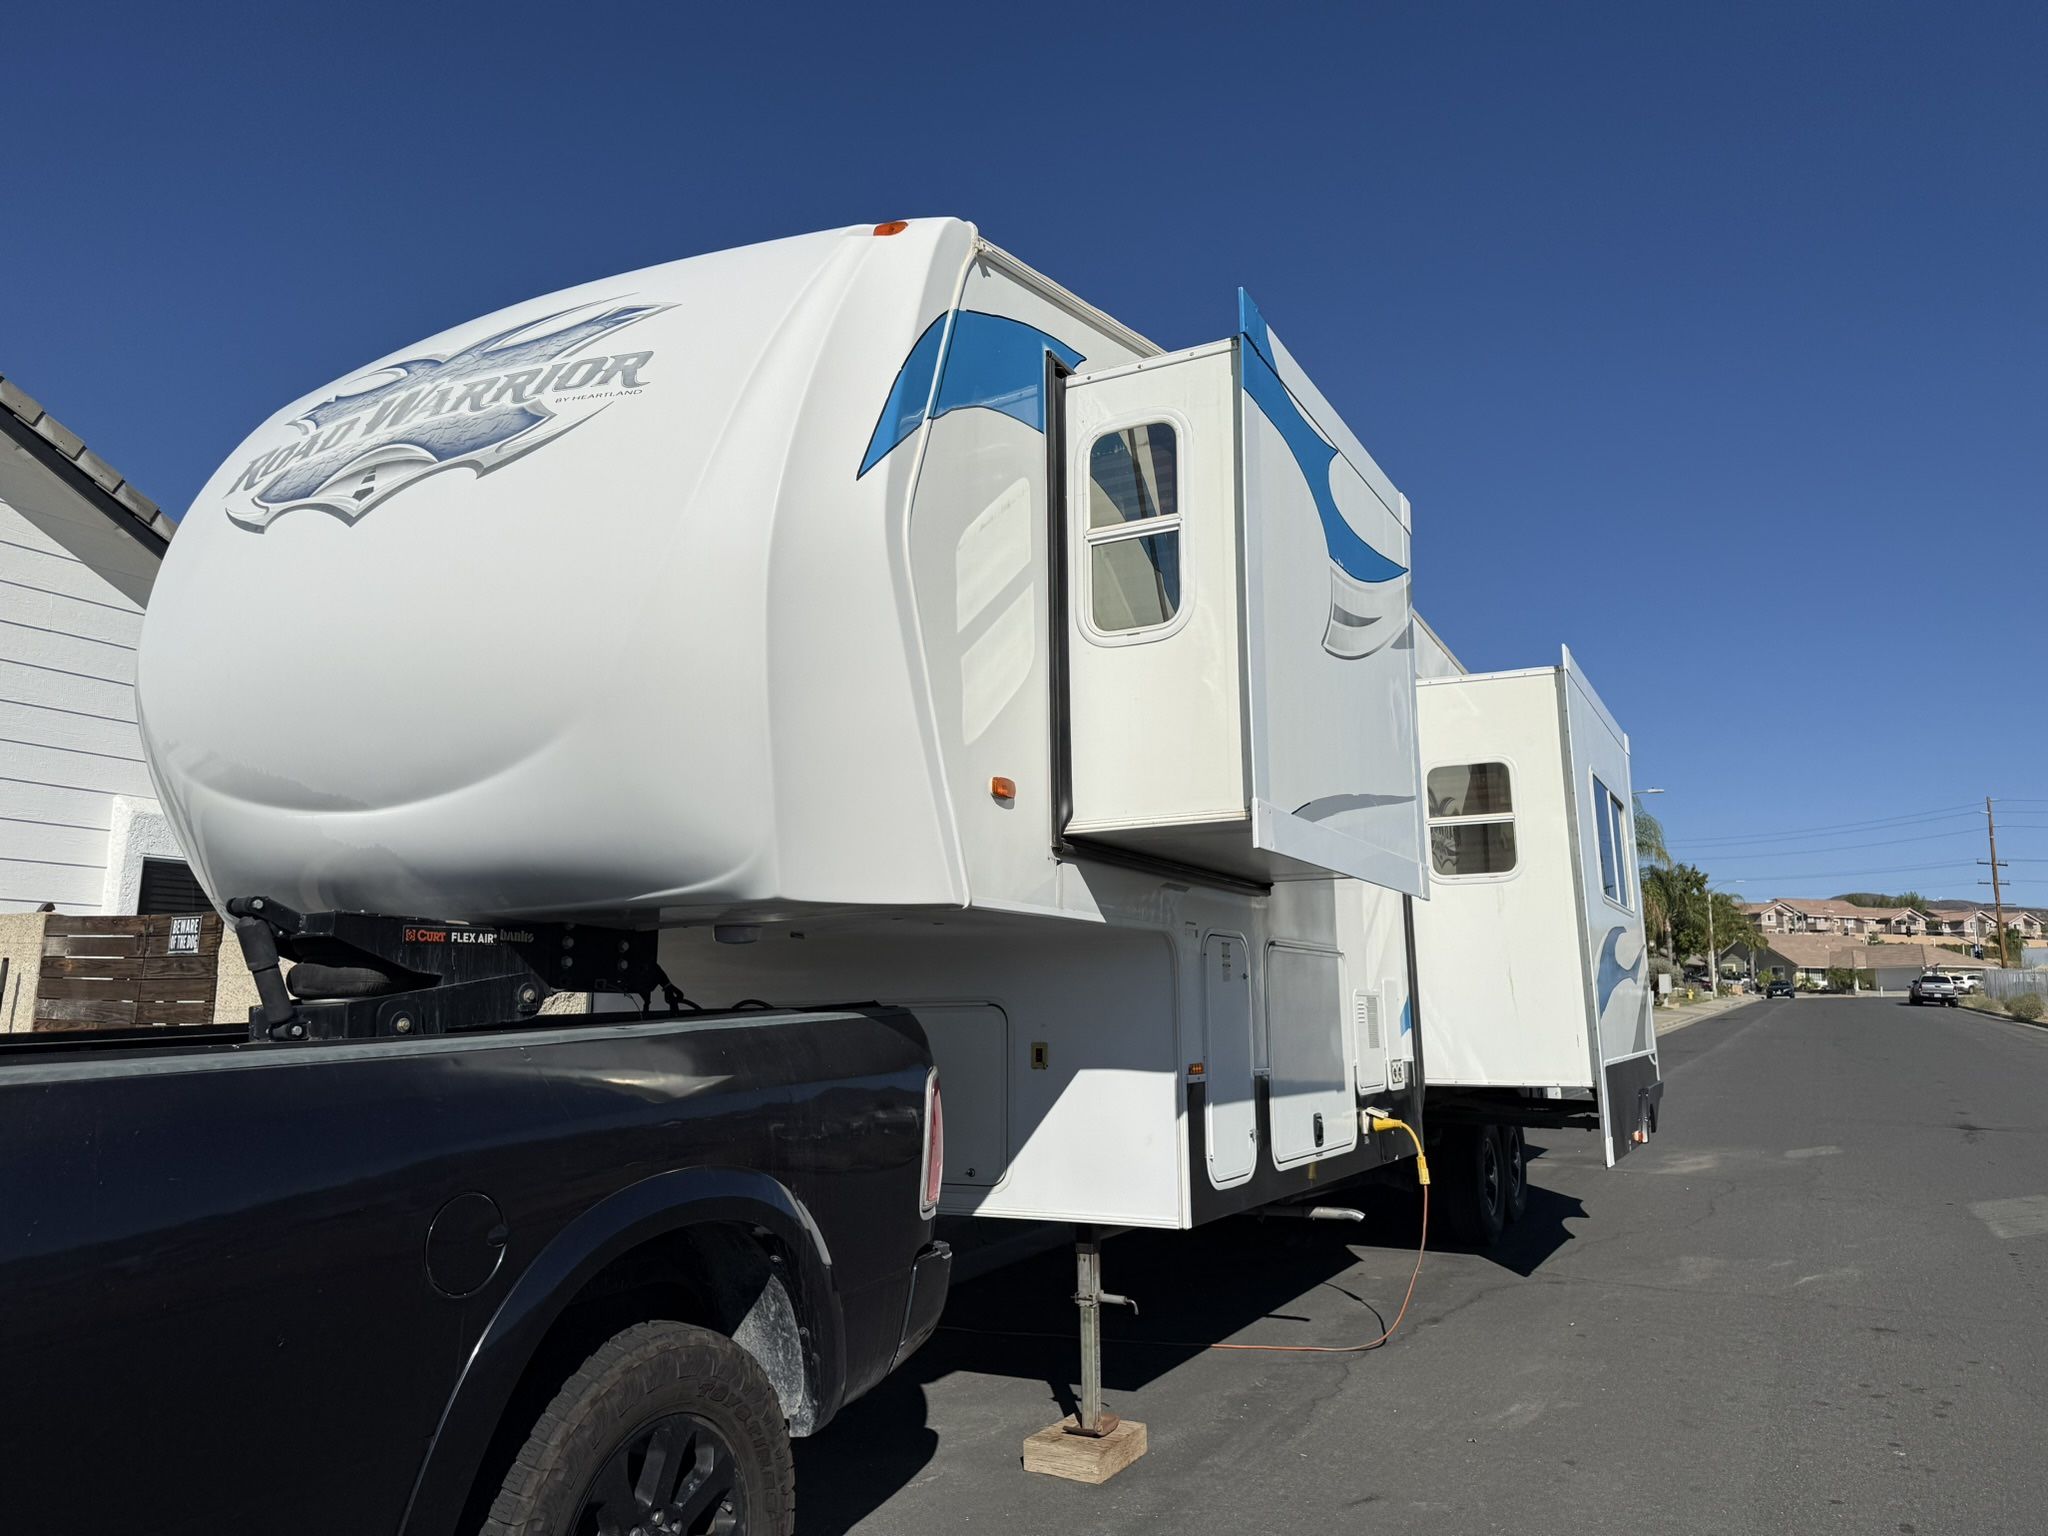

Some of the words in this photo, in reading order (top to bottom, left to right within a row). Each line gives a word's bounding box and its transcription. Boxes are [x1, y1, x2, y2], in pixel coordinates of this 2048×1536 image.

[572, 389, 643, 401] HEARTLAND
[222, 416, 361, 499] ROAD
[359, 350, 655, 438] WARRIOR
[172, 919, 199, 934] BEWARE
[417, 929, 447, 942] CURT
[451, 932, 476, 944] FLEX
